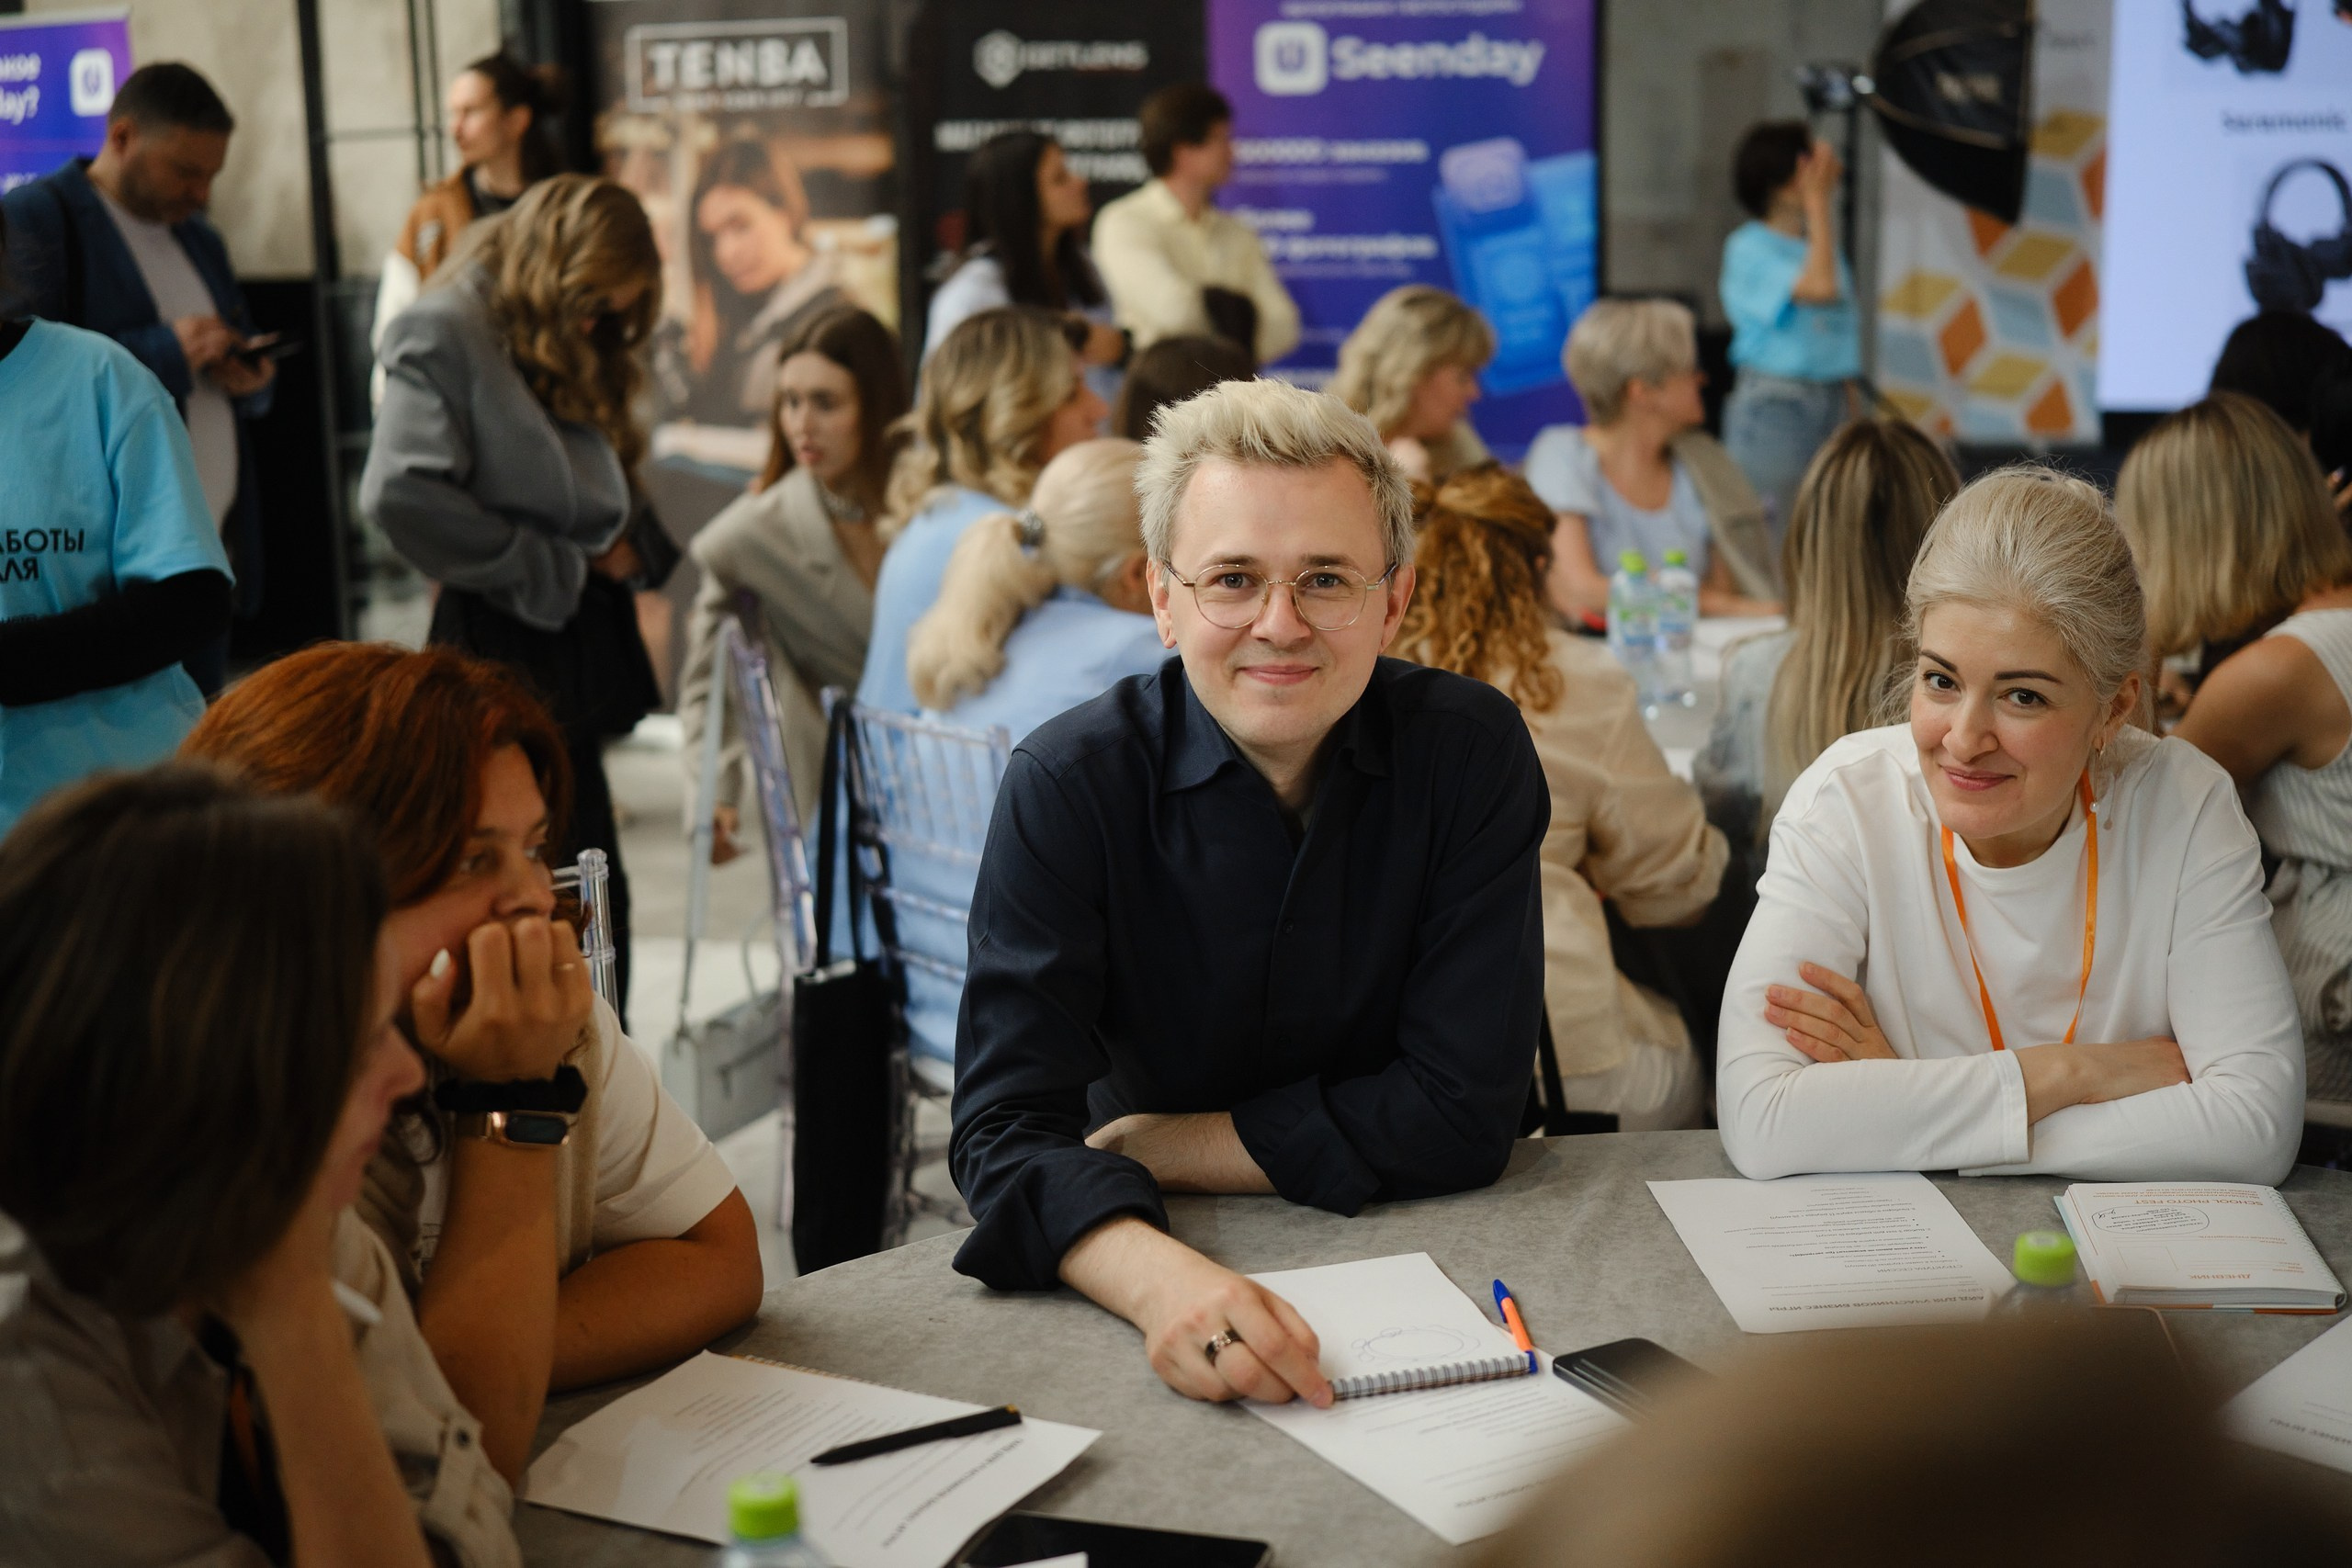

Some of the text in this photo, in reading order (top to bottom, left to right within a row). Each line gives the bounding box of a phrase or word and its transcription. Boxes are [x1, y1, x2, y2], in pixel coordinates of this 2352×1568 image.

[648, 39, 827, 89] TENBA
[1332, 34, 1546, 87] Seenday
[0, 556, 40, 583] ЛЯ
[1804, 1303, 1850, 1311] БИЗНЕС
[1853, 1298, 1931, 1308] УЧАСТНИКОВ
